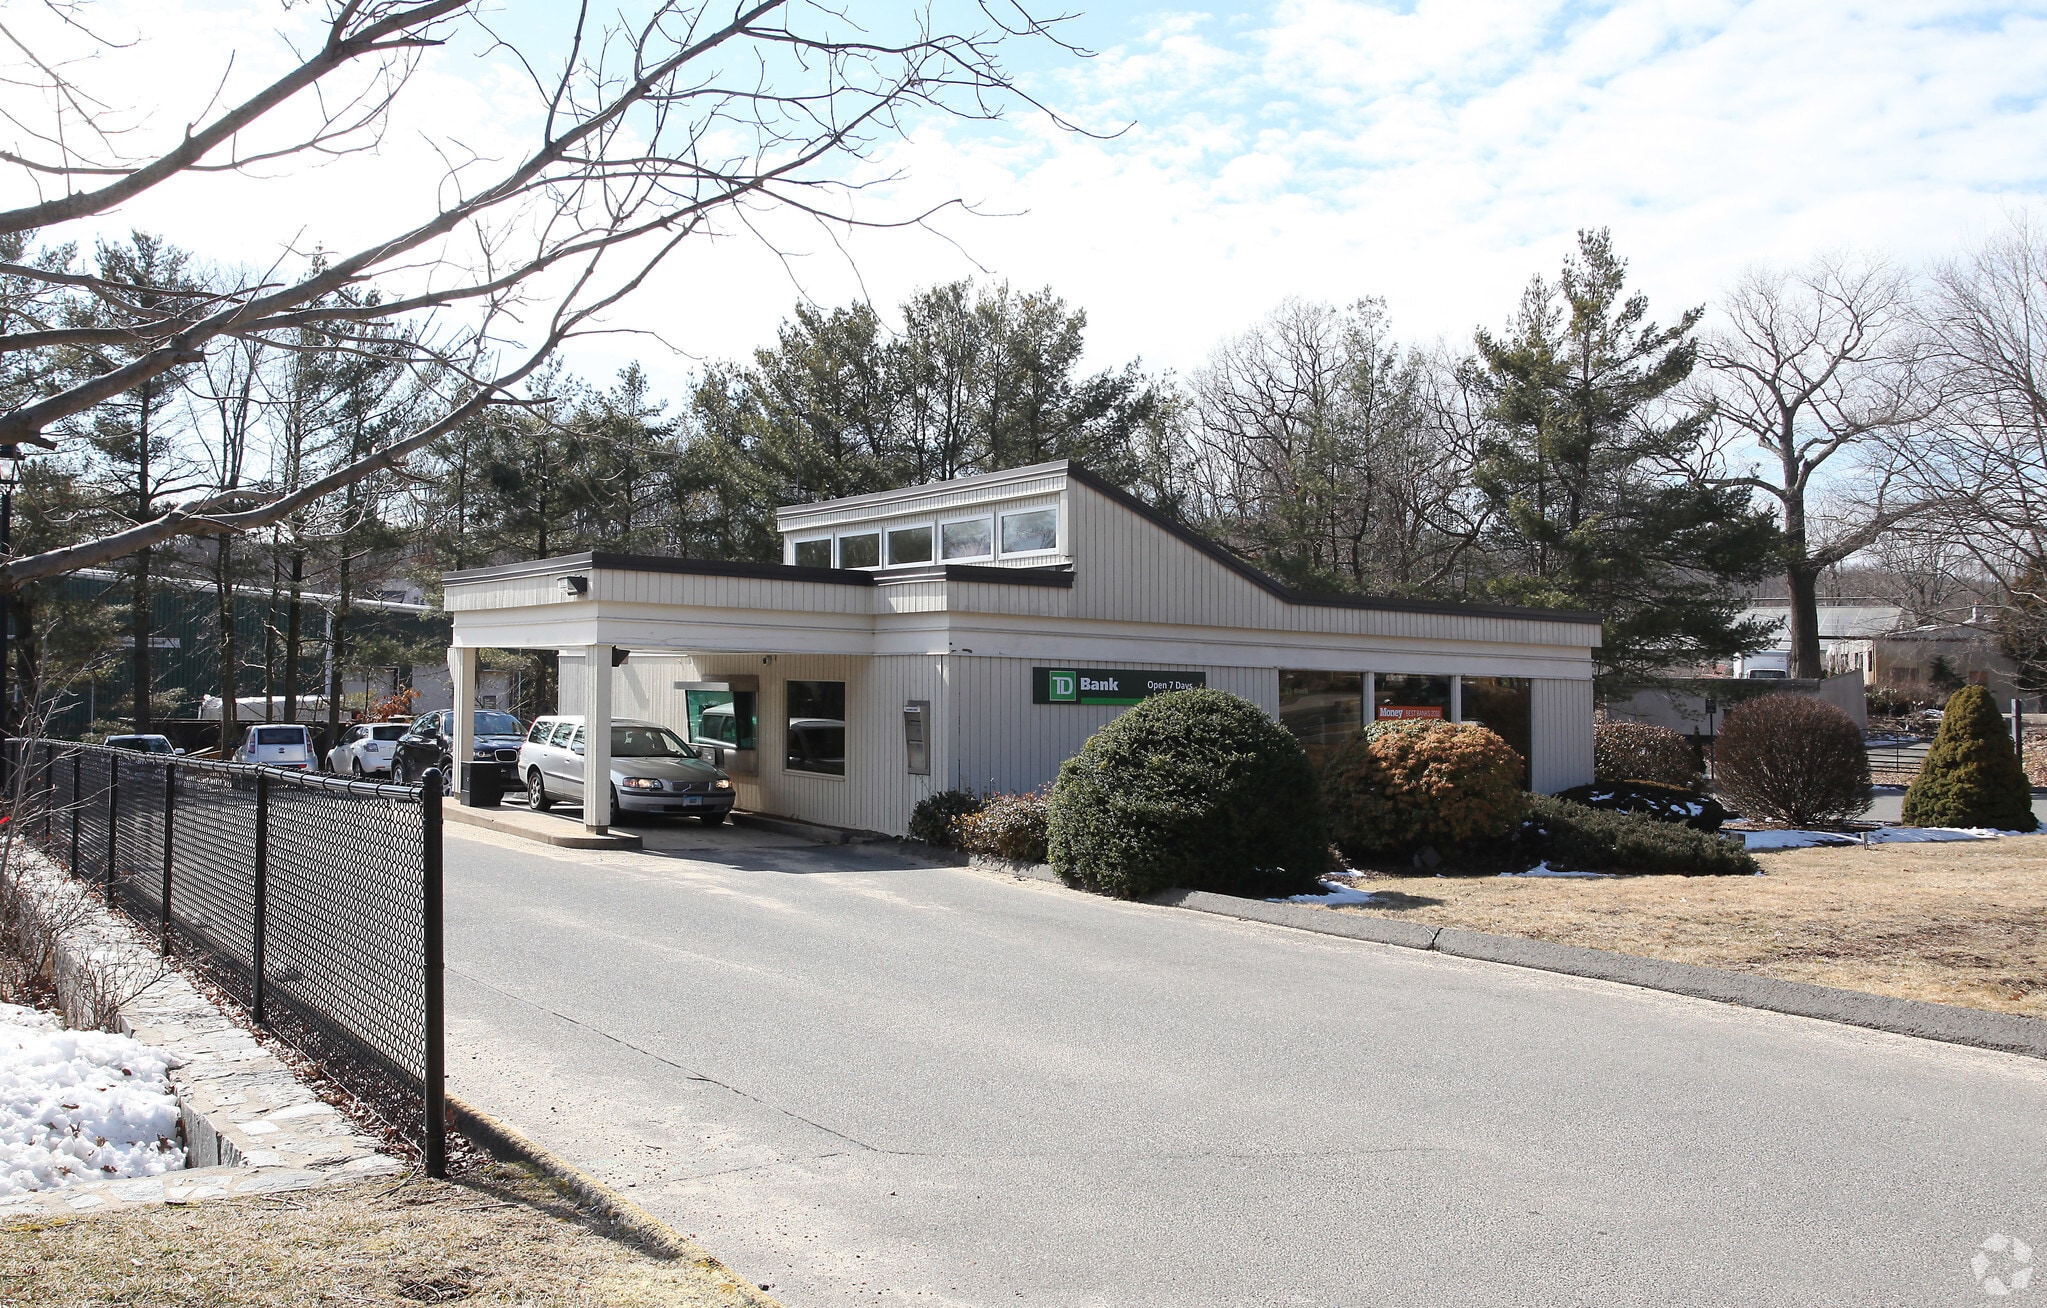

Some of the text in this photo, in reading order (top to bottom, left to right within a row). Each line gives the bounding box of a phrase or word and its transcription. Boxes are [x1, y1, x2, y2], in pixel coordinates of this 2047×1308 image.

[1052, 676, 1119, 695] TD Bank
[1147, 680, 1193, 691] Open 7 Days
[1379, 707, 1403, 719] Money
